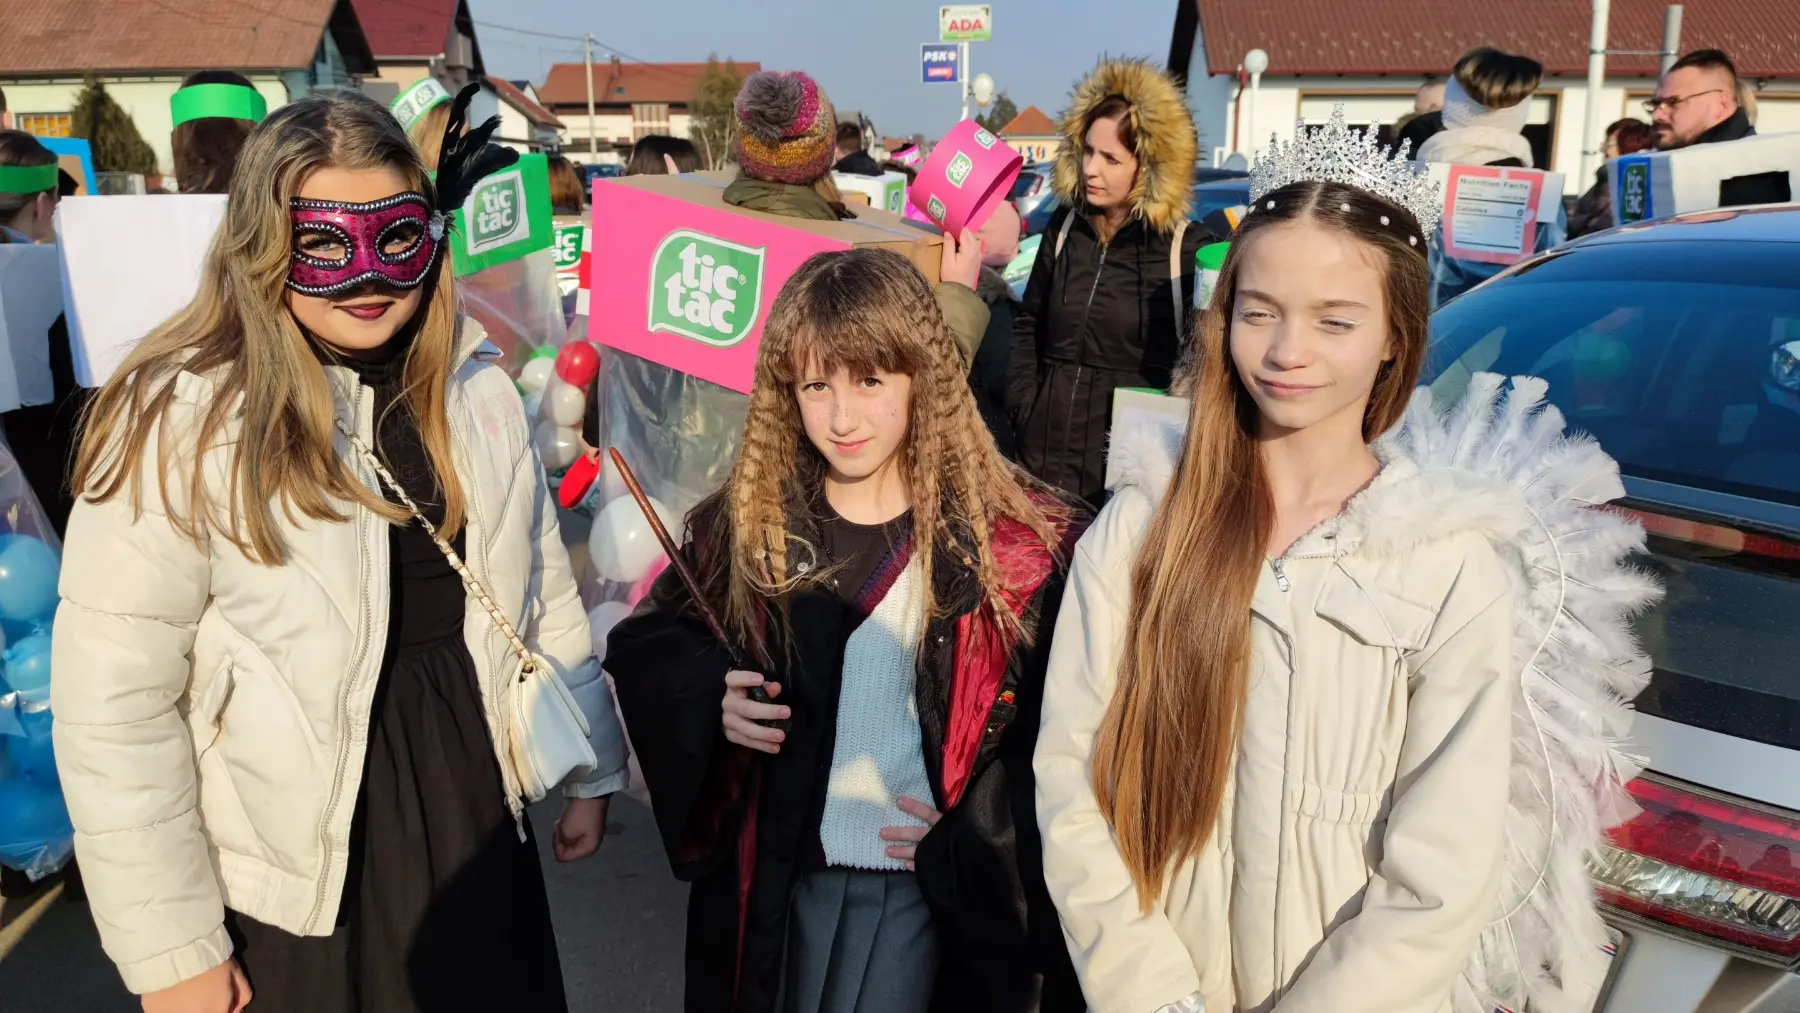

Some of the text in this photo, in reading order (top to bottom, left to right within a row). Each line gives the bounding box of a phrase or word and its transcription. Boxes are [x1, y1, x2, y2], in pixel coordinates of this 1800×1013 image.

[948, 18, 985, 32] ADA
[481, 186, 513, 213] tic
[477, 208, 513, 234] tac
[555, 229, 579, 249] ic
[679, 242, 739, 301] tic
[664, 272, 735, 334] tac
